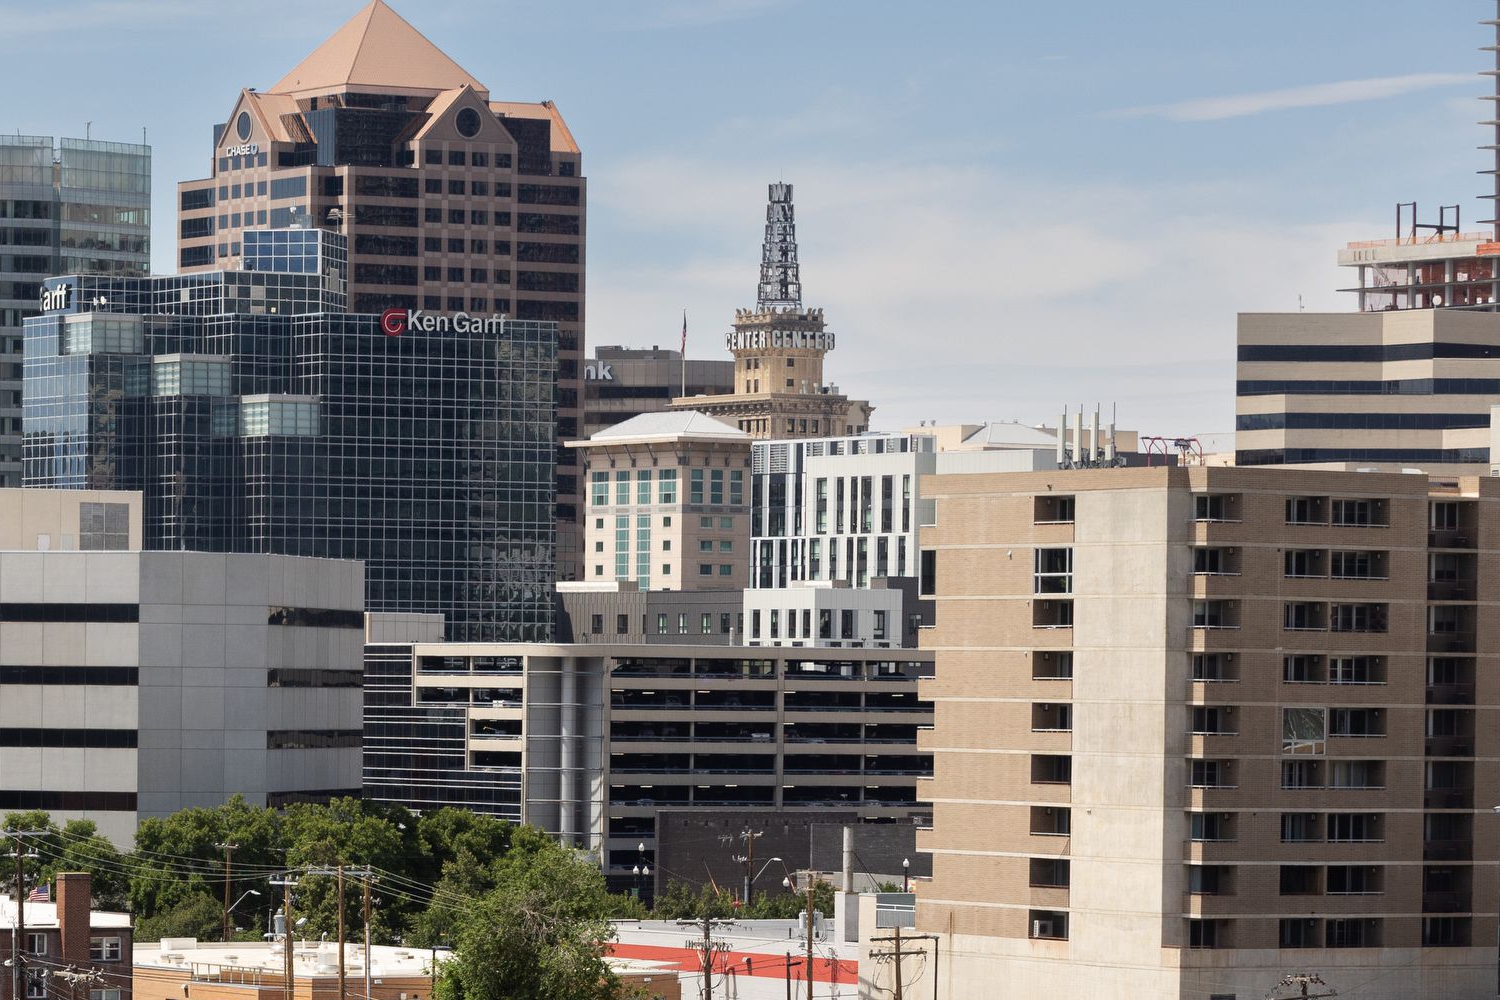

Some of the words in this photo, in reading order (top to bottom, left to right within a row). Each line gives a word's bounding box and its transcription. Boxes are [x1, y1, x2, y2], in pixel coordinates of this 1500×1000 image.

[226, 144, 251, 157] CHASE
[407, 309, 449, 332] Ken
[453, 311, 506, 334] Garff
[725, 330, 766, 351] CENTER
[772, 330, 835, 350] CENTER
